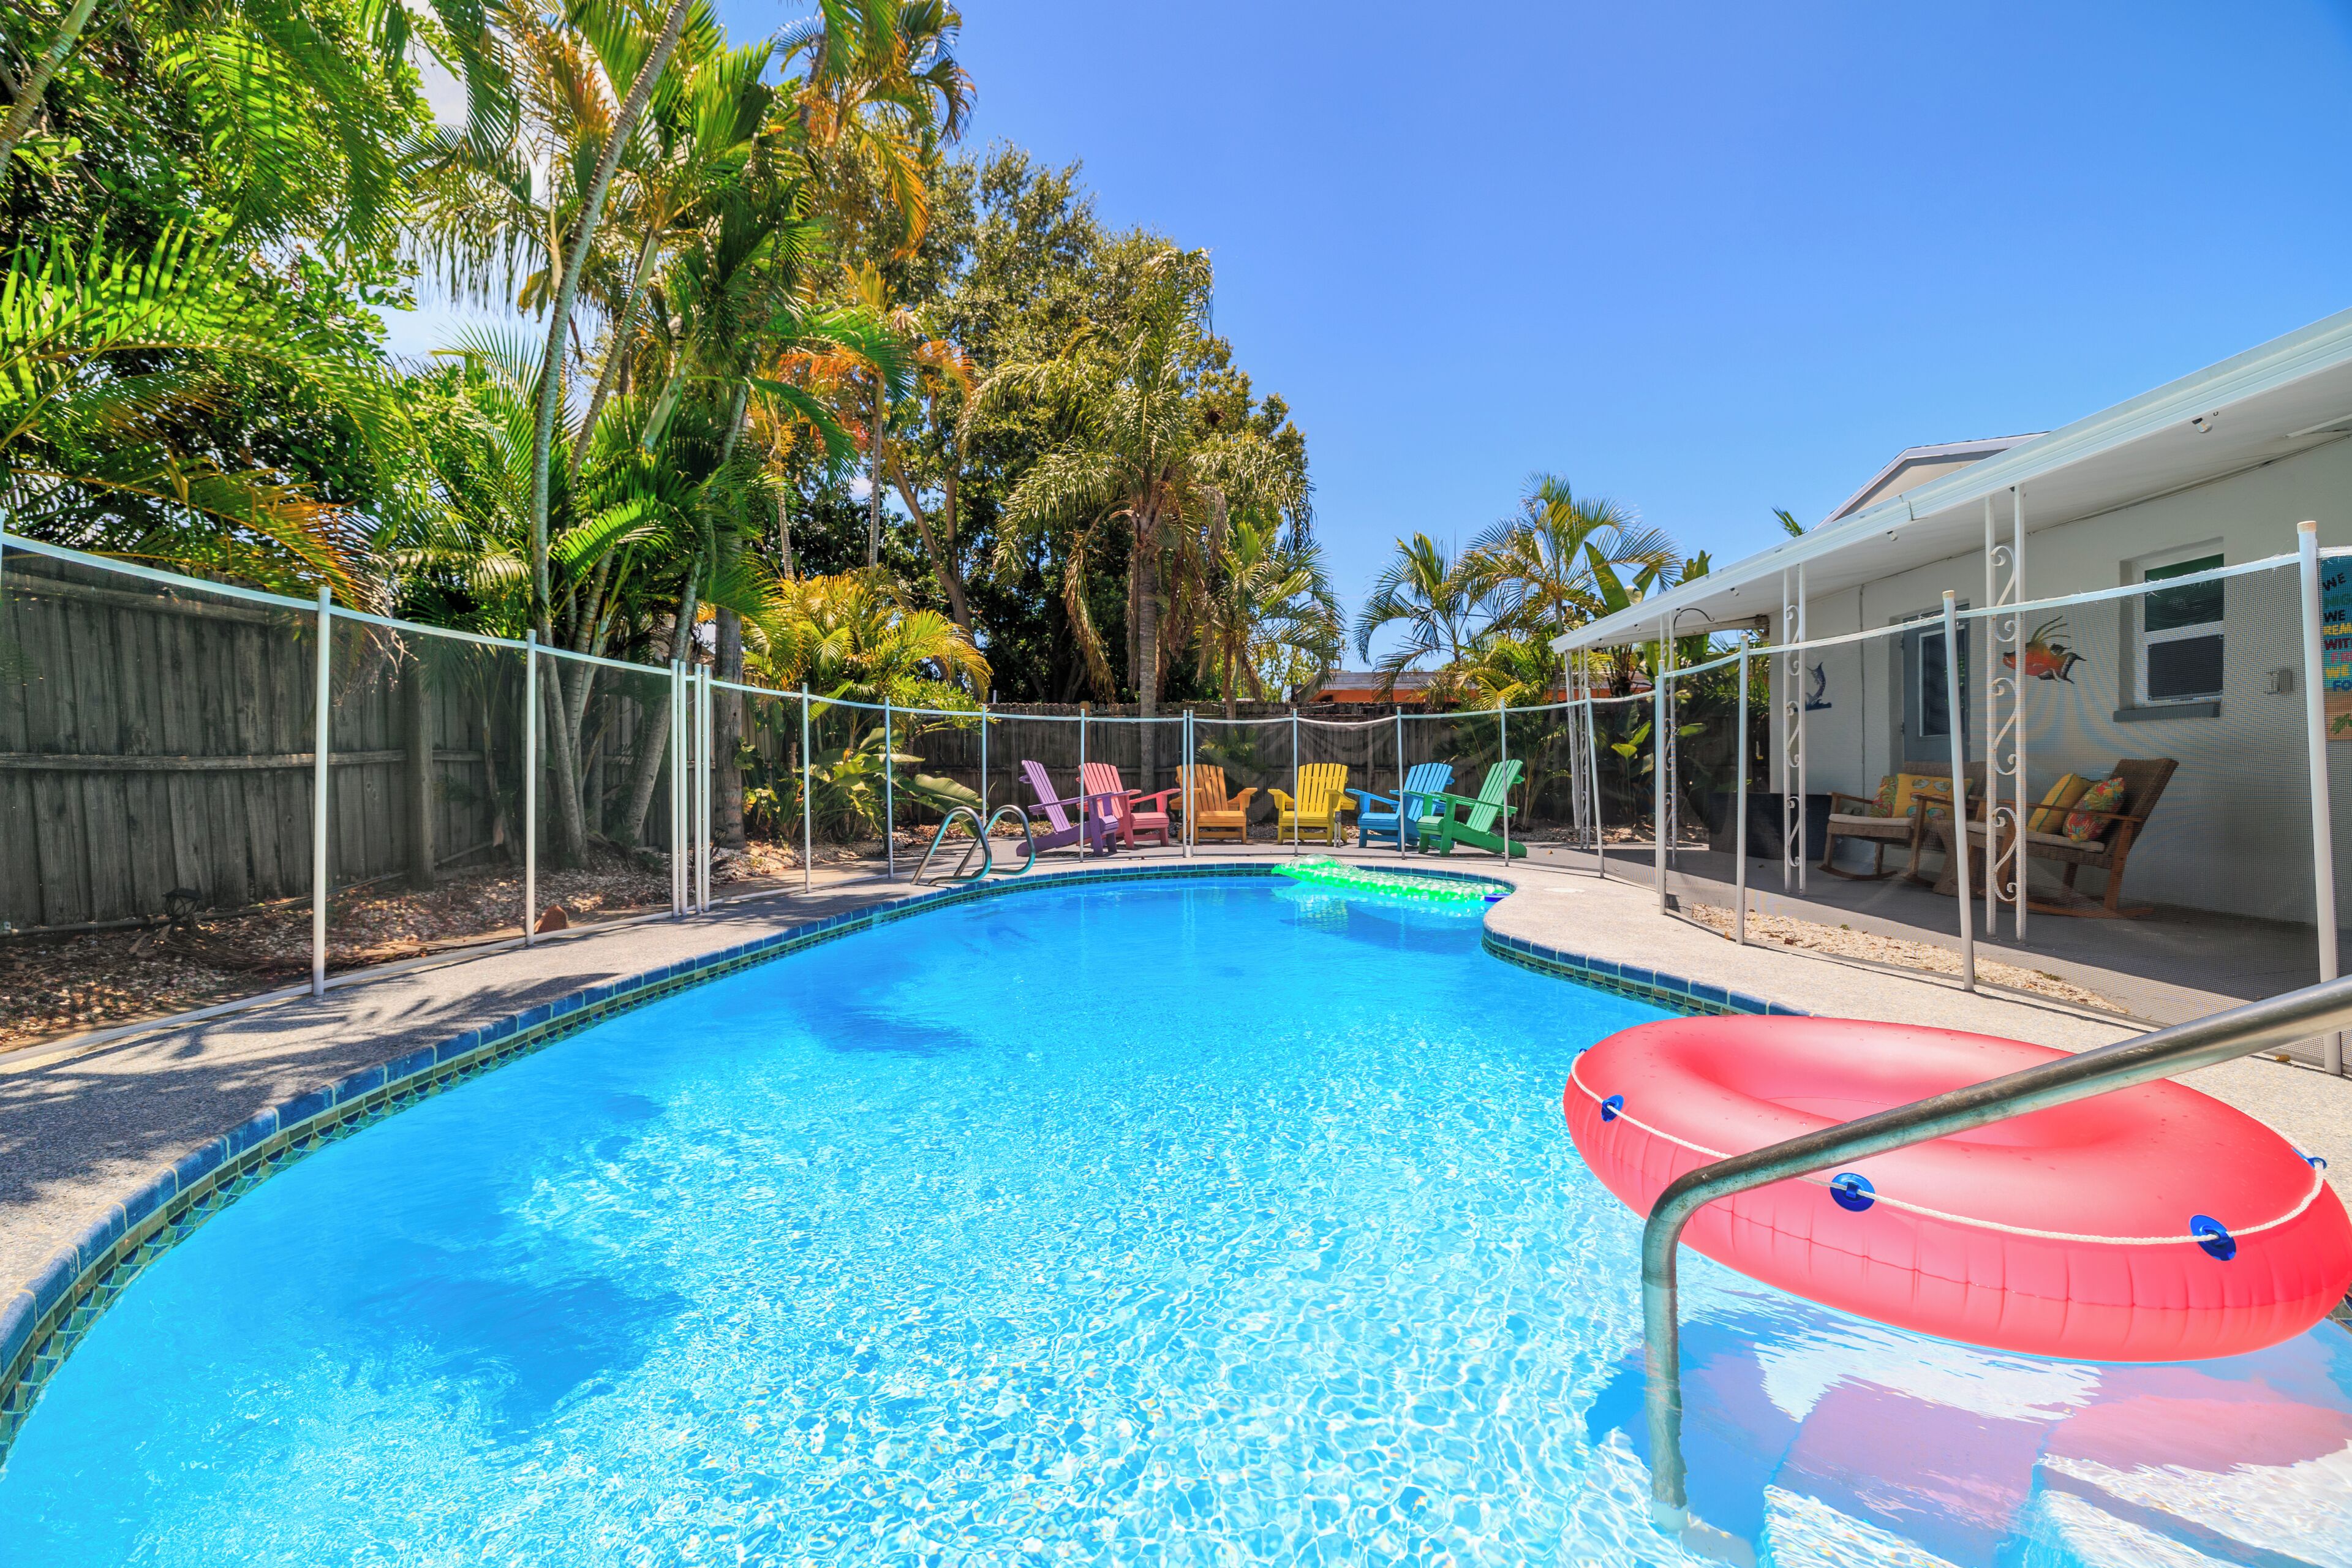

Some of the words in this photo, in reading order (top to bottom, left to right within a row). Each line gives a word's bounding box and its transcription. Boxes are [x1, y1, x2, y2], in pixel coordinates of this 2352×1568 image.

[2323, 573, 2346, 591] WE
[2324, 609, 2345, 622] WE
[2324, 638, 2352, 650] WIT
[2326, 664, 2349, 679] WE
